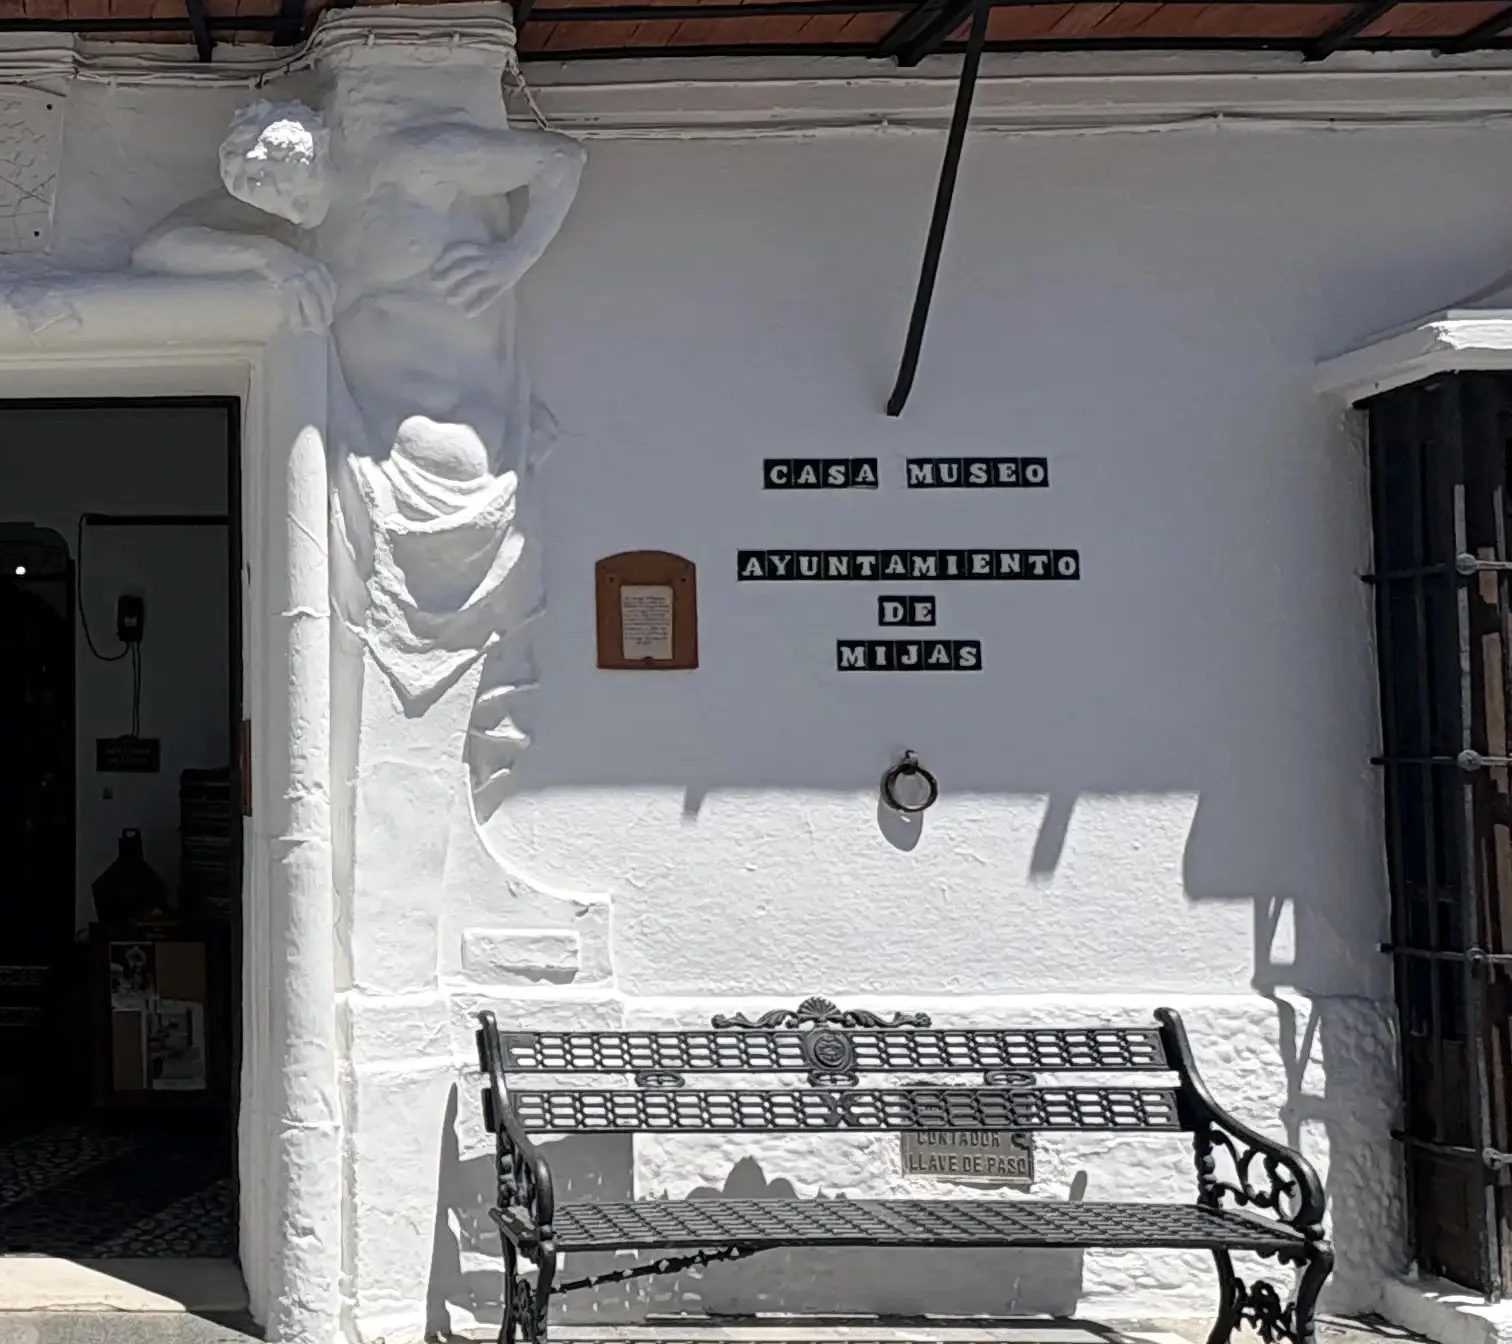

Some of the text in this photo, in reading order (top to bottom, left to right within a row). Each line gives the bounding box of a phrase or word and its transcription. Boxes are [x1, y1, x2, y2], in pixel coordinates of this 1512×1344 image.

[768, 460, 1047, 487] CASA MUSEO
[740, 553, 1078, 578] AYUNTAMIENTO
[882, 600, 933, 623] DE
[839, 643, 979, 668] MIJAS
[917, 1131, 1001, 1148] CONTADOR
[908, 1153, 1028, 1175] LLAVE DE PASO
